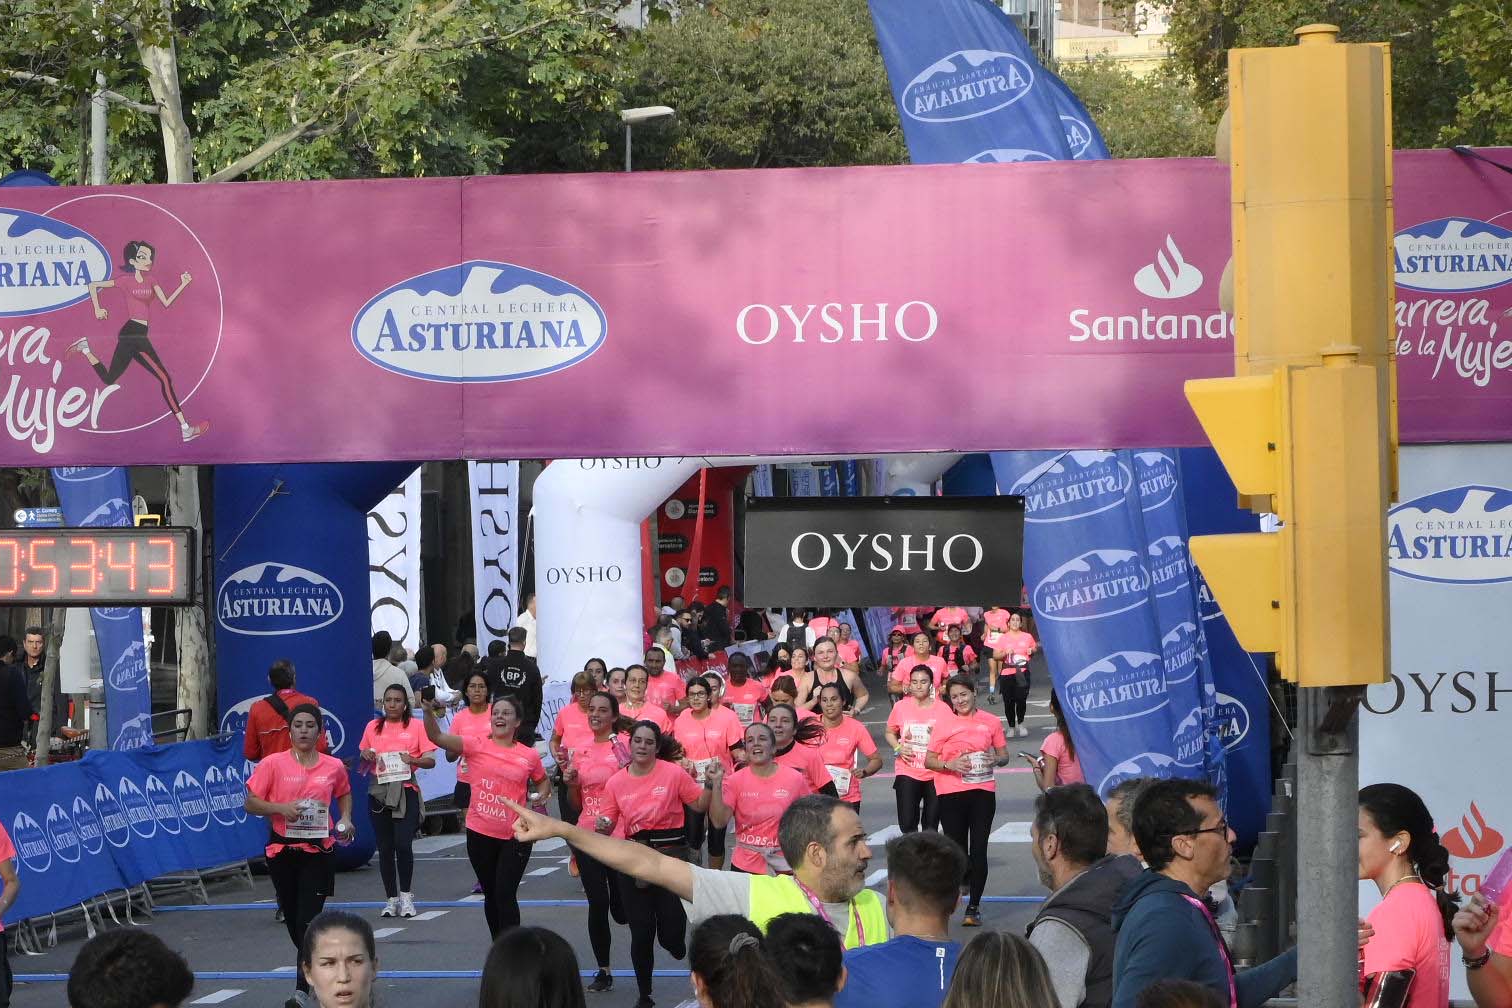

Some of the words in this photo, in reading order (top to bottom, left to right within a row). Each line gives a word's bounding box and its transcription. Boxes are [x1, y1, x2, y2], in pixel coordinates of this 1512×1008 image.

[15, 244, 87, 256] LECHERA
[1408, 242, 1460, 252] CENTRAL
[1465, 242, 1511, 251] LECHER
[411, 303, 489, 317] CENTRAL
[498, 301, 579, 315] LECHERA
[1394, 298, 1490, 328] arrera
[372, 308, 587, 353] ASTURIANA
[736, 300, 939, 345] OYSHO
[1069, 308, 1235, 342] Santand
[1418, 328, 1436, 357] la
[1430, 322, 1512, 387] Muje
[1416, 519, 1483, 531] CENTRAL
[791, 532, 984, 573] OYSHO
[546, 564, 623, 585] OYSHO
[233, 587, 275, 597] CENTRAL
[280, 586, 330, 597] LECHERA
[219, 593, 333, 619] ASTURIANA
